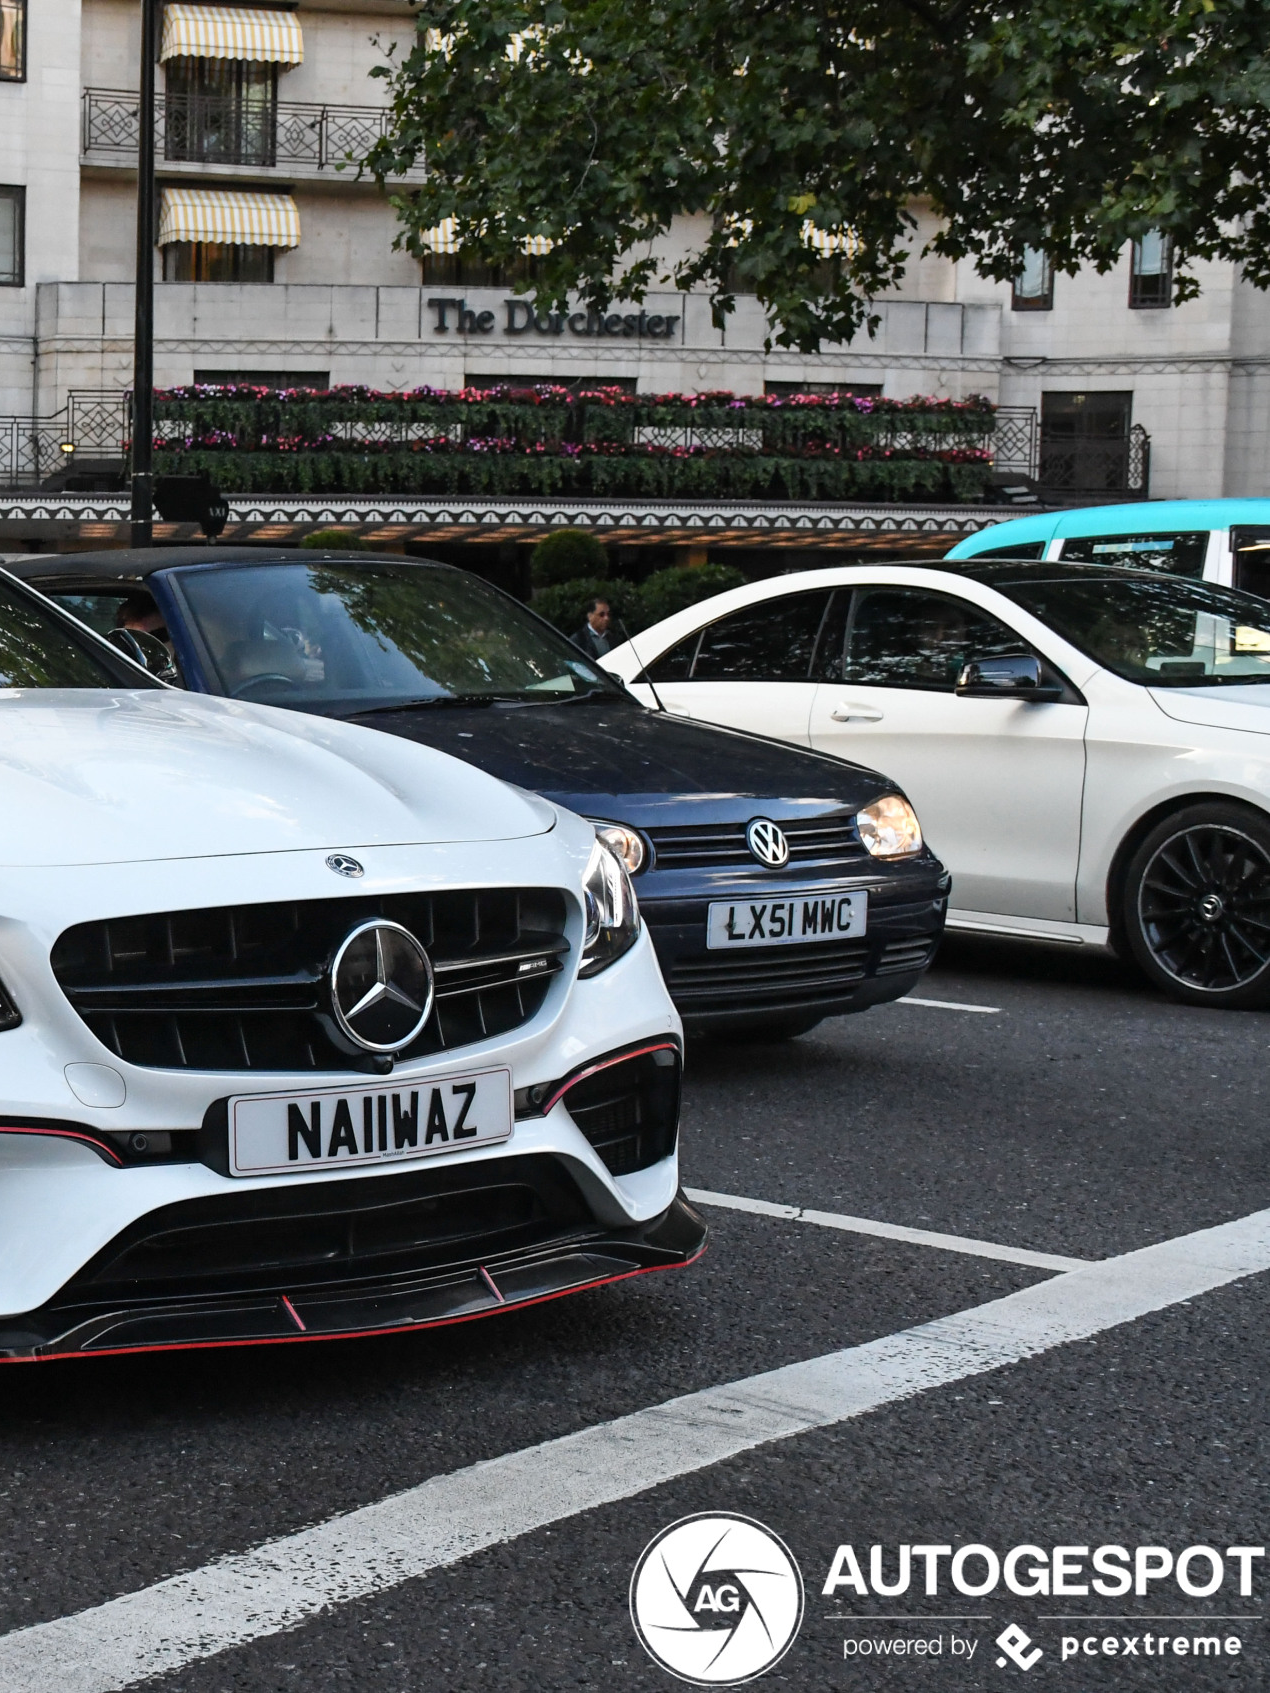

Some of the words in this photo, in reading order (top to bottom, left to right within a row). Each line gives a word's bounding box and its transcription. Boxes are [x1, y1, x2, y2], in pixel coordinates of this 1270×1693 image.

[428, 298, 494, 333] The
[504, 299, 680, 337] Dorchester
[728, 903, 793, 941] LX51
[802, 898, 851, 935] MWC
